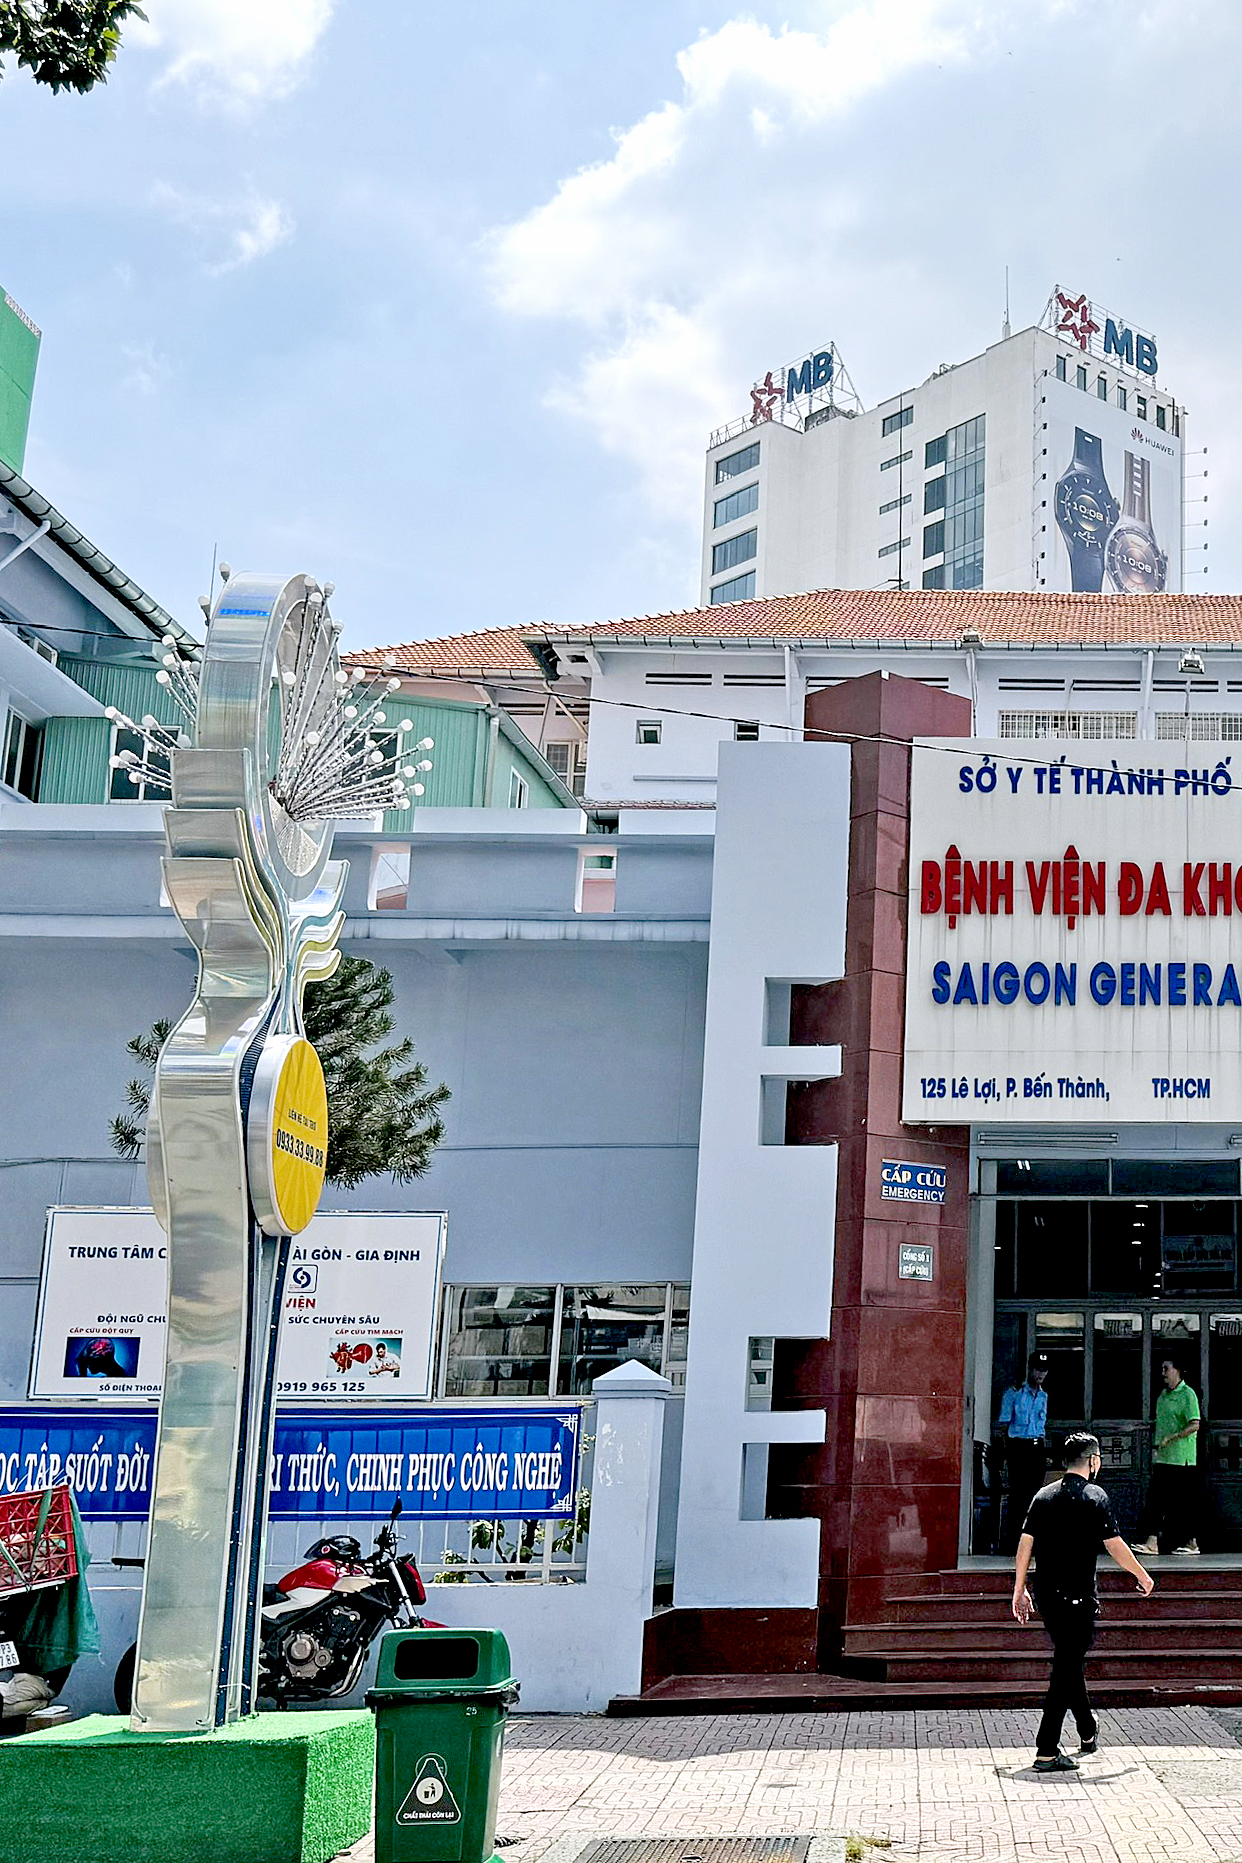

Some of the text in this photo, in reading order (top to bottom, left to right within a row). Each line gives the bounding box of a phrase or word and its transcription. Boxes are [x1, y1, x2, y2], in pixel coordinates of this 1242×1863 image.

[1104, 318, 1158, 376] MB
[787, 352, 833, 403] MB
[1145, 436, 1175, 456] HUAWEI
[959, 756, 997, 794] SỞ
[1006, 767, 1023, 794] Y
[1033, 755, 1066, 794] TẾ
[1071, 759, 1164, 795] THÀNH
[1174, 756, 1232, 796] PHỐ
[920, 844, 1014, 930] BỆNH
[1025, 844, 1106, 931] VIỆN
[1117, 861, 1172, 917] ĐA
[932, 960, 1077, 1006] SAIGON
[920, 1072, 1211, 1103] 125 Lê Lợi, P. Bến Thành, TP.HCM
[882, 1164, 946, 1188] CẤP CỨU
[882, 1185, 945, 1202] EMERGENCY
[69, 1246, 118, 1259] TRUNG
[122, 1244, 154, 1259] TÂM
[292, 1246, 307, 1260] ÀI
[311, 1246, 342, 1261] GÒN
[355, 1250, 380, 1261] GIA
[383, 1250, 420, 1263] ĐỊNH
[97, 1313, 117, 1325] ĐỘI
[120, 1313, 144, 1324] NGŨ
[288, 1314, 380, 1324] SỨC CHUYÊN SÂU
[99, 1383, 110, 1392] SỐ
[113, 1384, 133, 1392] ĐIỆN
[312, 1382, 337, 1392] 965
[342, 1382, 365, 1392] 125
[65, 1434, 112, 1492] SUỐT
[115, 1442, 150, 1492] ĐỜI
[288, 1442, 339, 1496] THỨC,
[346, 1453, 404, 1492] CHINH
[407, 1453, 455, 1500] PHỤC
[460, 1442, 508, 1492] CÔNG
[512, 1442, 563, 1499] NGHỆ
[466, 1707, 477, 1716] 25
